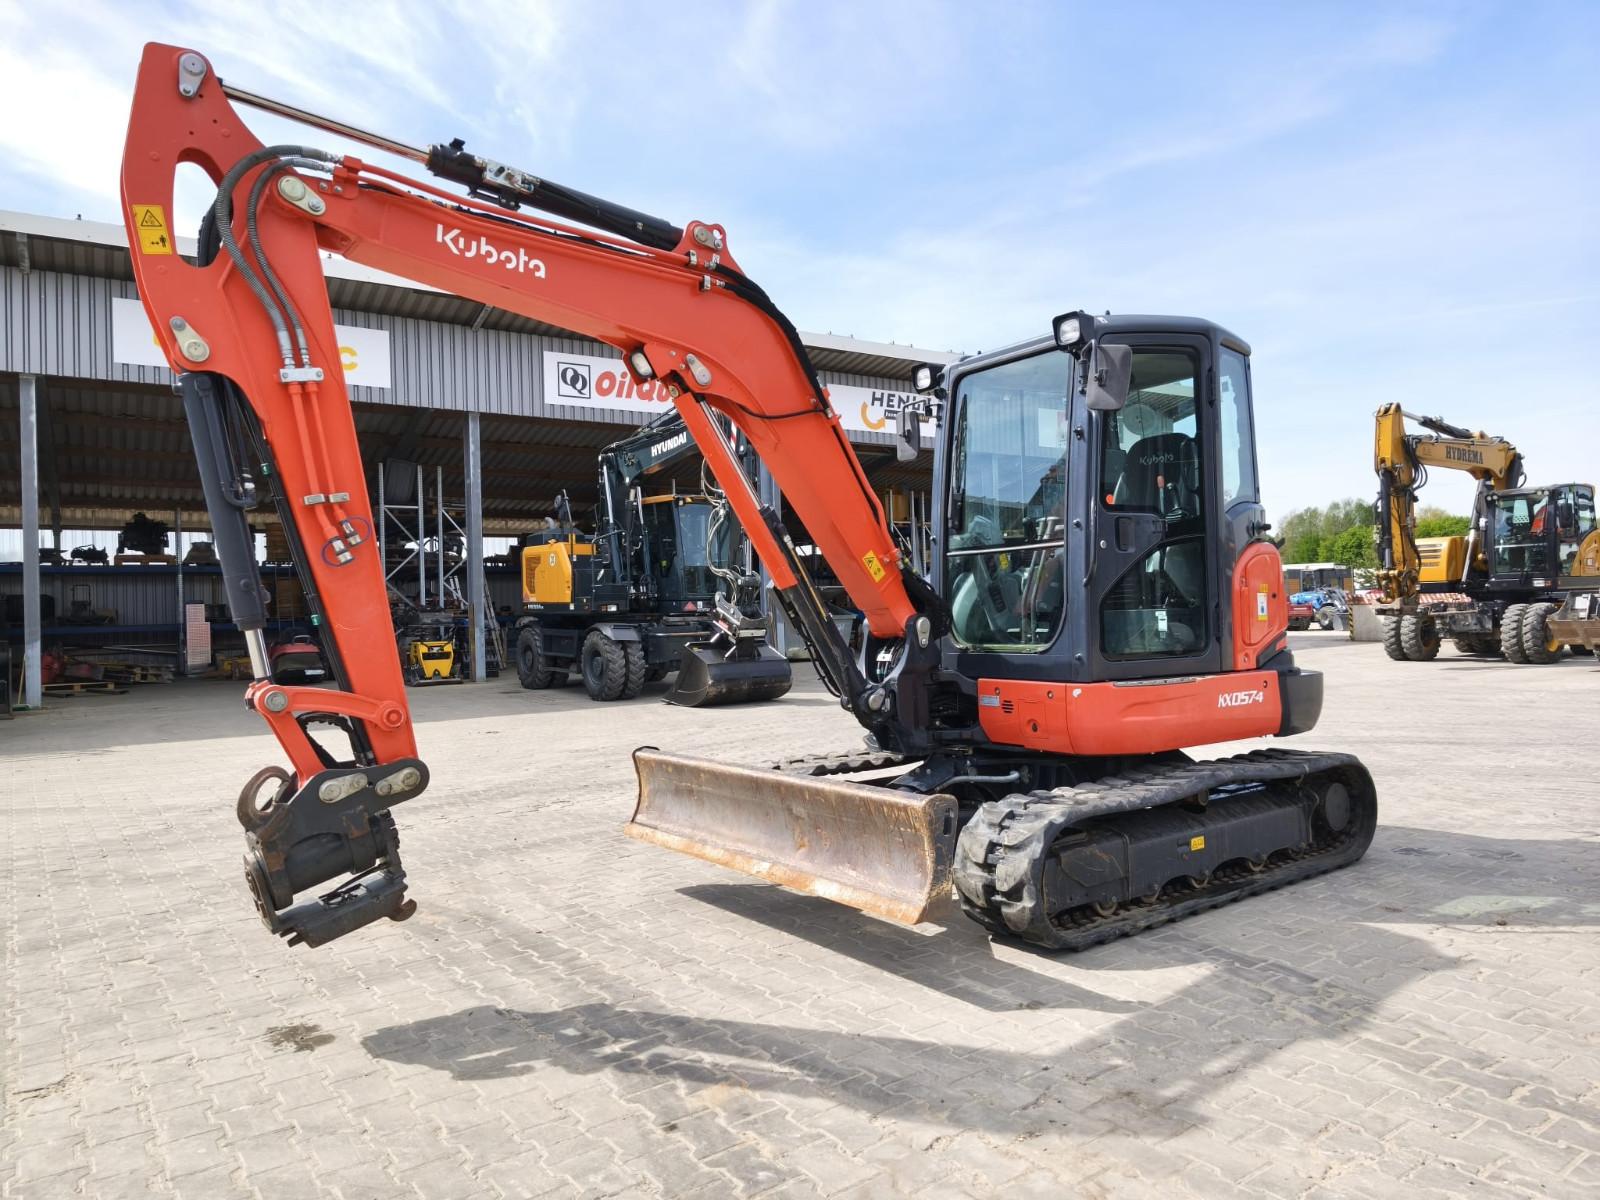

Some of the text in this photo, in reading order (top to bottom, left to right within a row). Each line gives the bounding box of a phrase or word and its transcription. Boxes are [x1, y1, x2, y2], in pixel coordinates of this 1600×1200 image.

[436, 223, 546, 279] Kubota
[651, 431, 687, 457] HYUNDAI
[1445, 445, 1484, 465] HYDREMA
